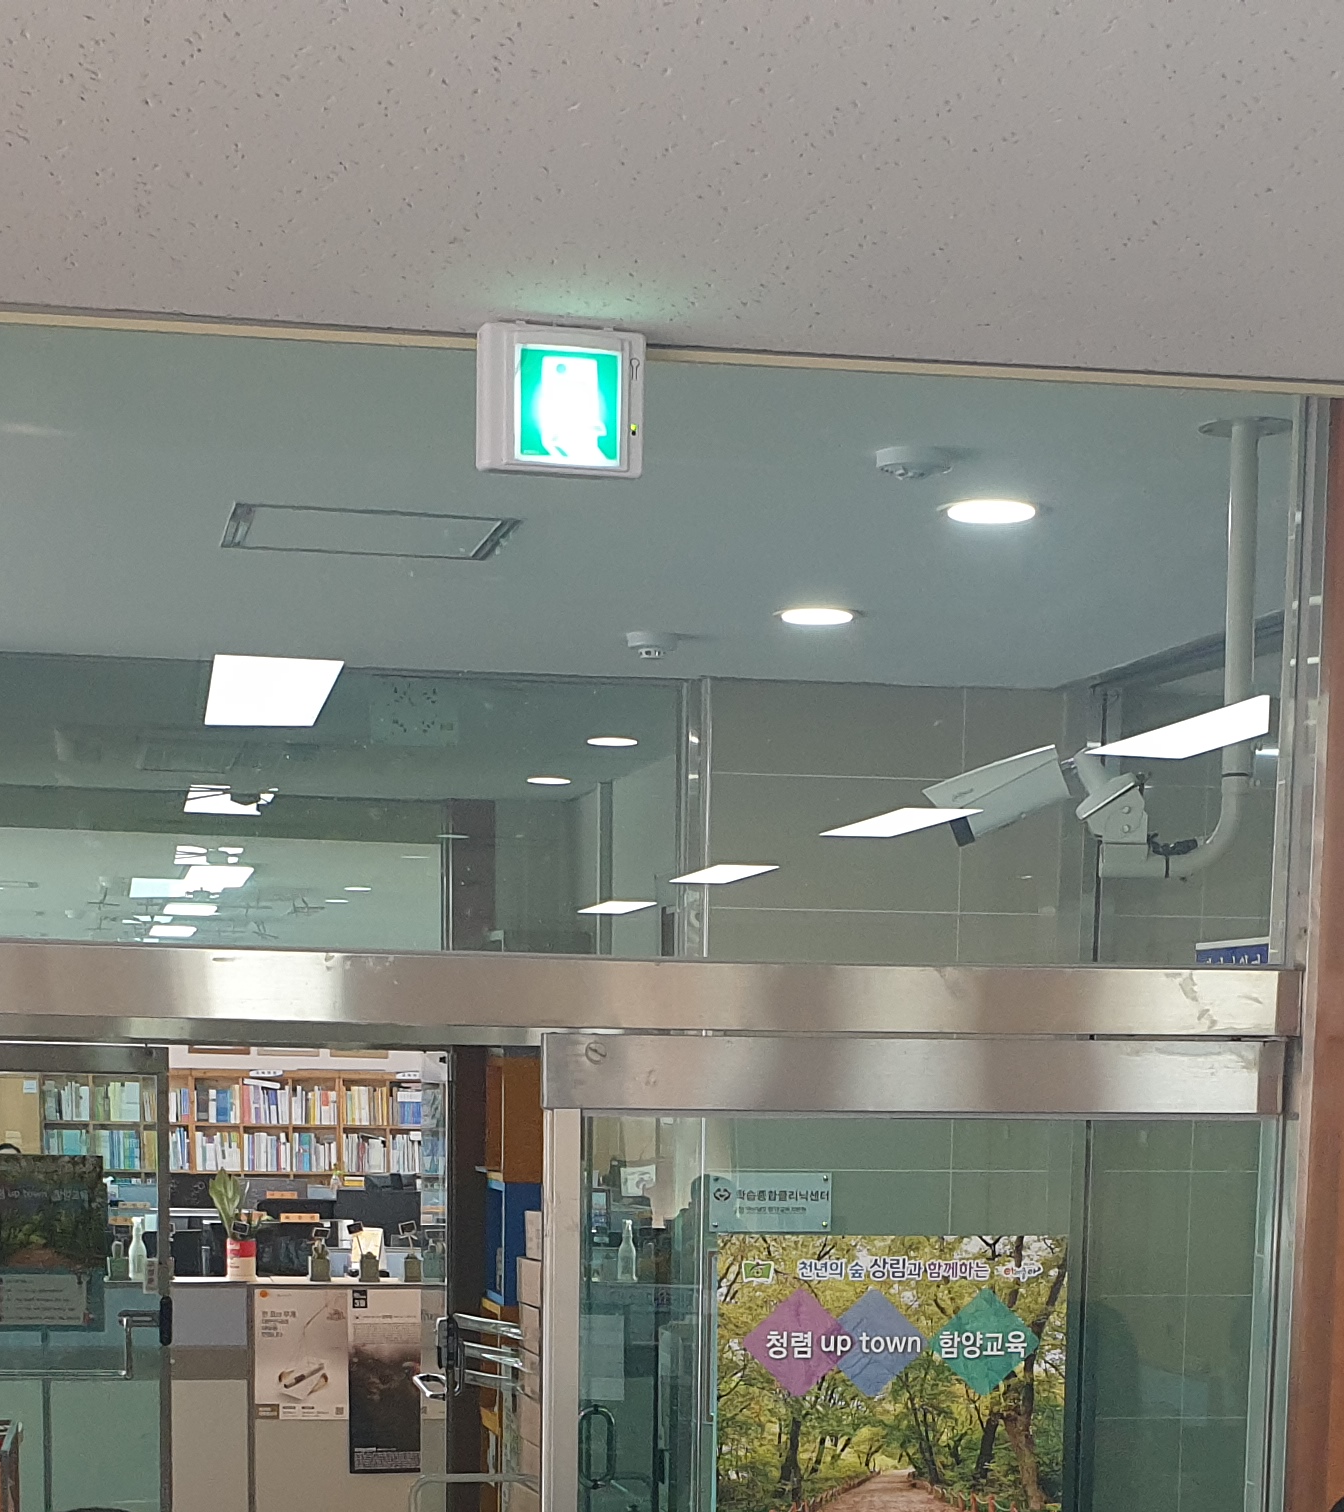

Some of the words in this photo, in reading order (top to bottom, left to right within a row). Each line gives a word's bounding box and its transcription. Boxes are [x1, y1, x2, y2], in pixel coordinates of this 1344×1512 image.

[798, 1260, 845, 1279] 천년의
[849, 1260, 864, 1280] 숲
[869, 1257, 924, 1280] 상림과
[927, 1260, 990, 1279] 함께하는
[766, 1331, 813, 1359] 청렴
[821, 1334, 852, 1357] up
[859, 1332, 922, 1354] town
[939, 1331, 1028, 1359] 함양교육
